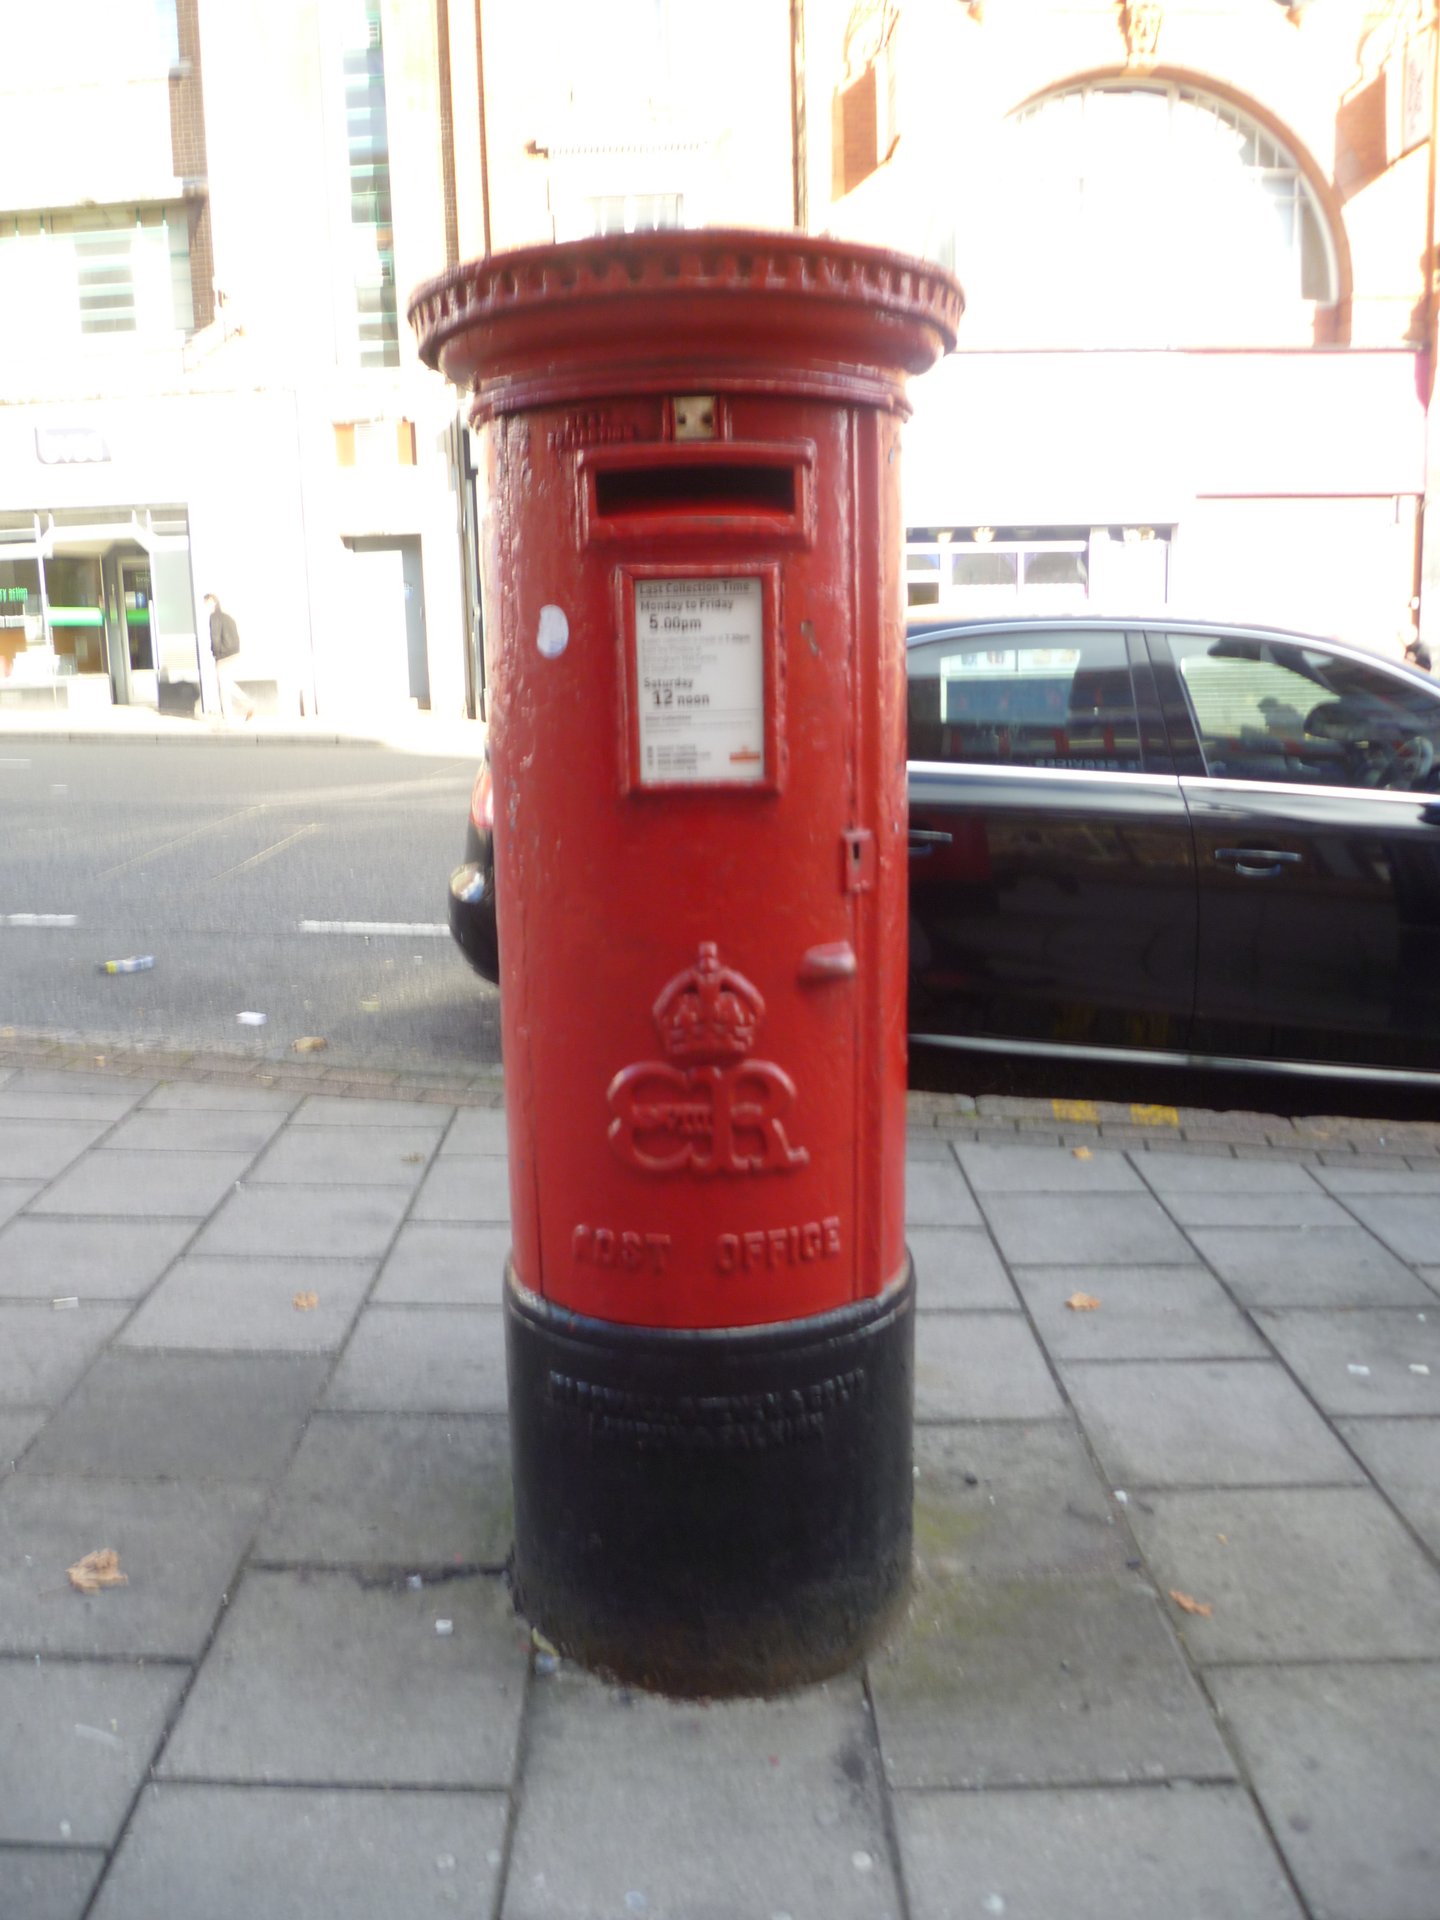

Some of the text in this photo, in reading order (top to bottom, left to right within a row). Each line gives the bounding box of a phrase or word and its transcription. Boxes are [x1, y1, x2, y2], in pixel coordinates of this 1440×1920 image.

[640, 583, 663, 594] Last
[666, 581, 719, 593] Collection
[640, 598, 734, 611] Monday to Friday
[649, 614, 702, 632] 5.00pm
[644, 677, 693, 690] Saturday
[653, 689, 710, 706] 12 noon
[571, 1214, 842, 1275] POST OFFICE
